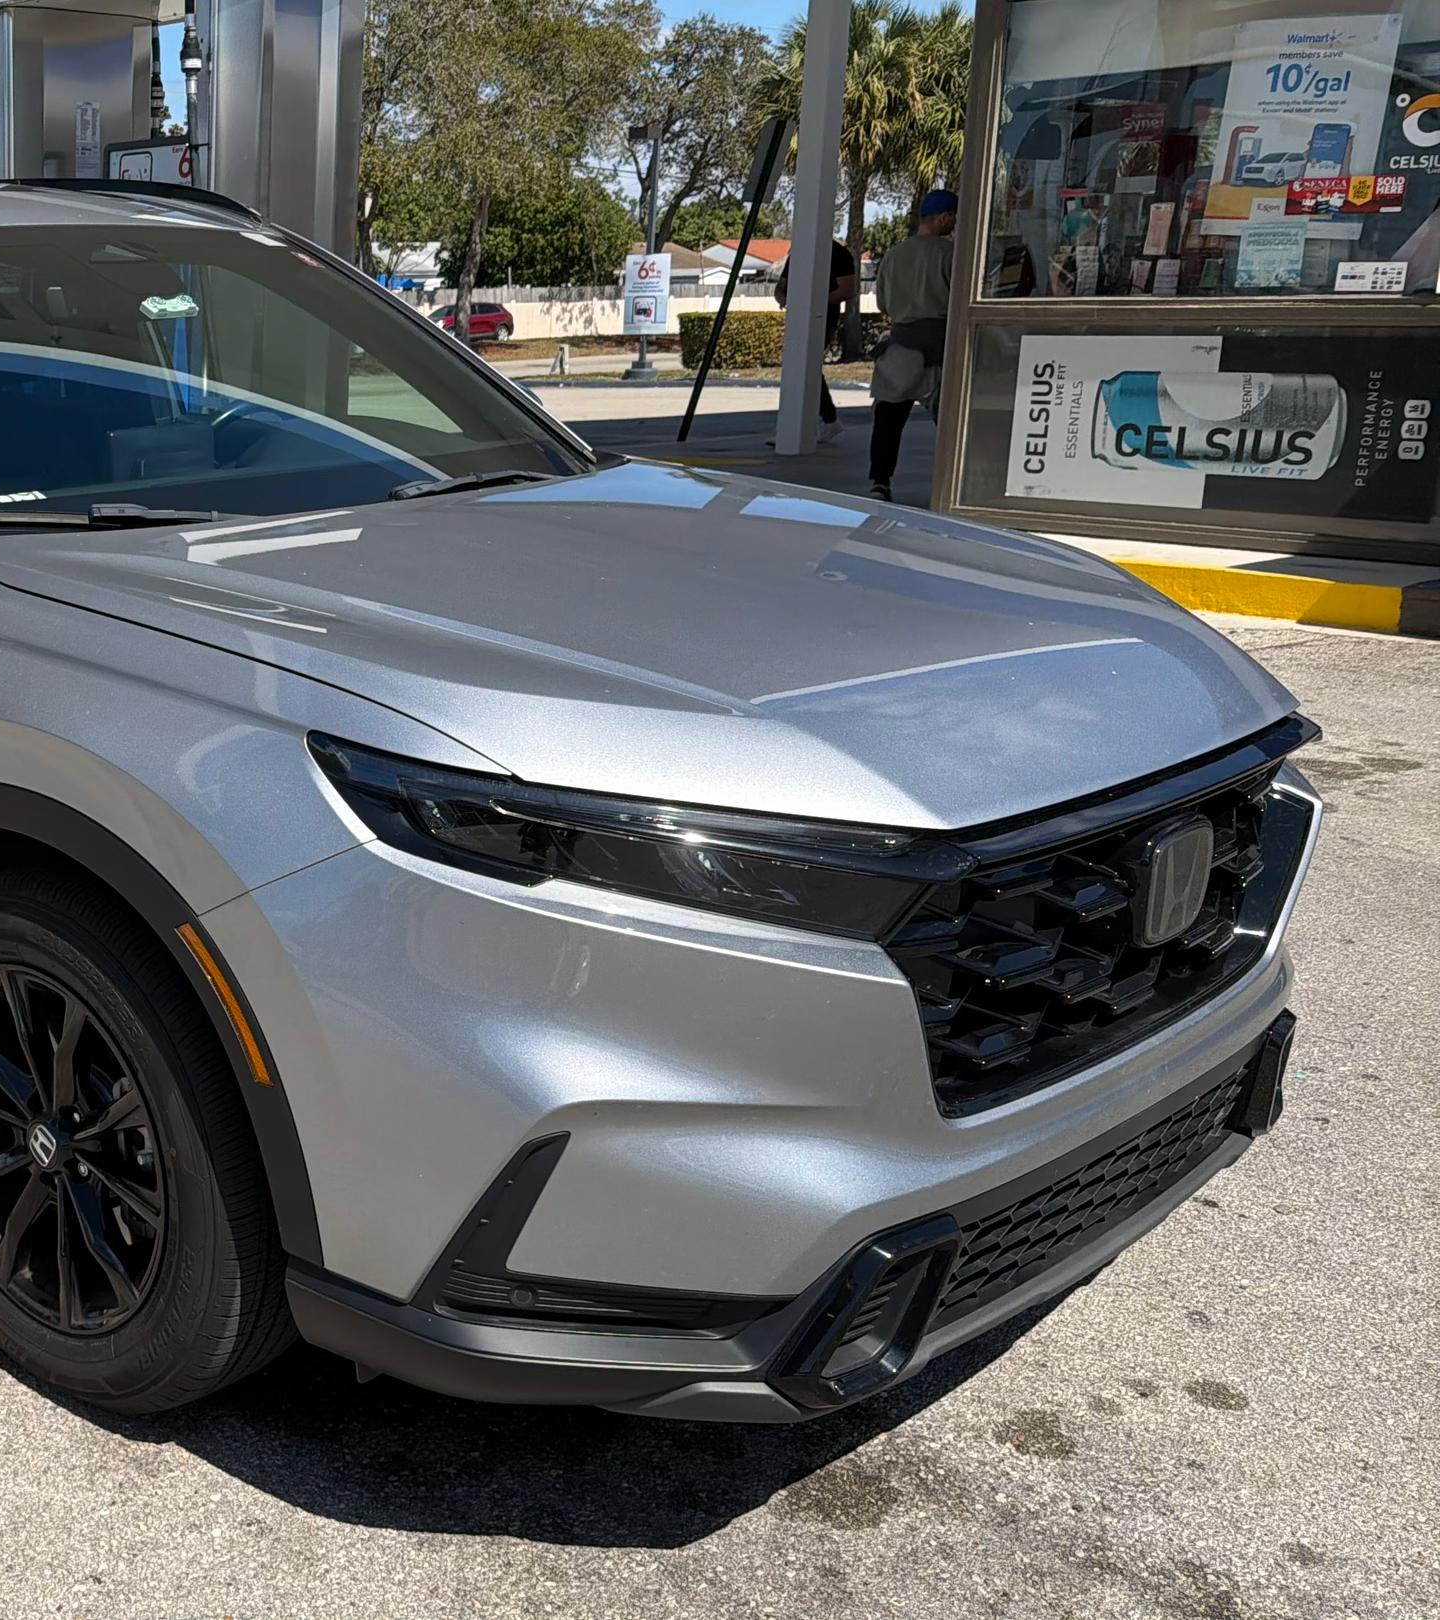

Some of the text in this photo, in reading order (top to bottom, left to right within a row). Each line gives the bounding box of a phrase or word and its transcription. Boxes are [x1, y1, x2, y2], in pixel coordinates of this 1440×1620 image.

[1279, 50, 1344, 60] members save
[1375, 184, 1405, 195] HERE
[1376, 176, 1406, 187] SOLD
[1054, 363, 1067, 407] LIVE FIT
[1064, 380, 1084, 459] ESSENTIALS
[1354, 370, 1383, 487] PERFORMANCE
[1374, 398, 1395, 460] ENERGY
[1115, 422, 1316, 466] CELSIUS
[1231, 465, 1309, 477] LIVE FIT
